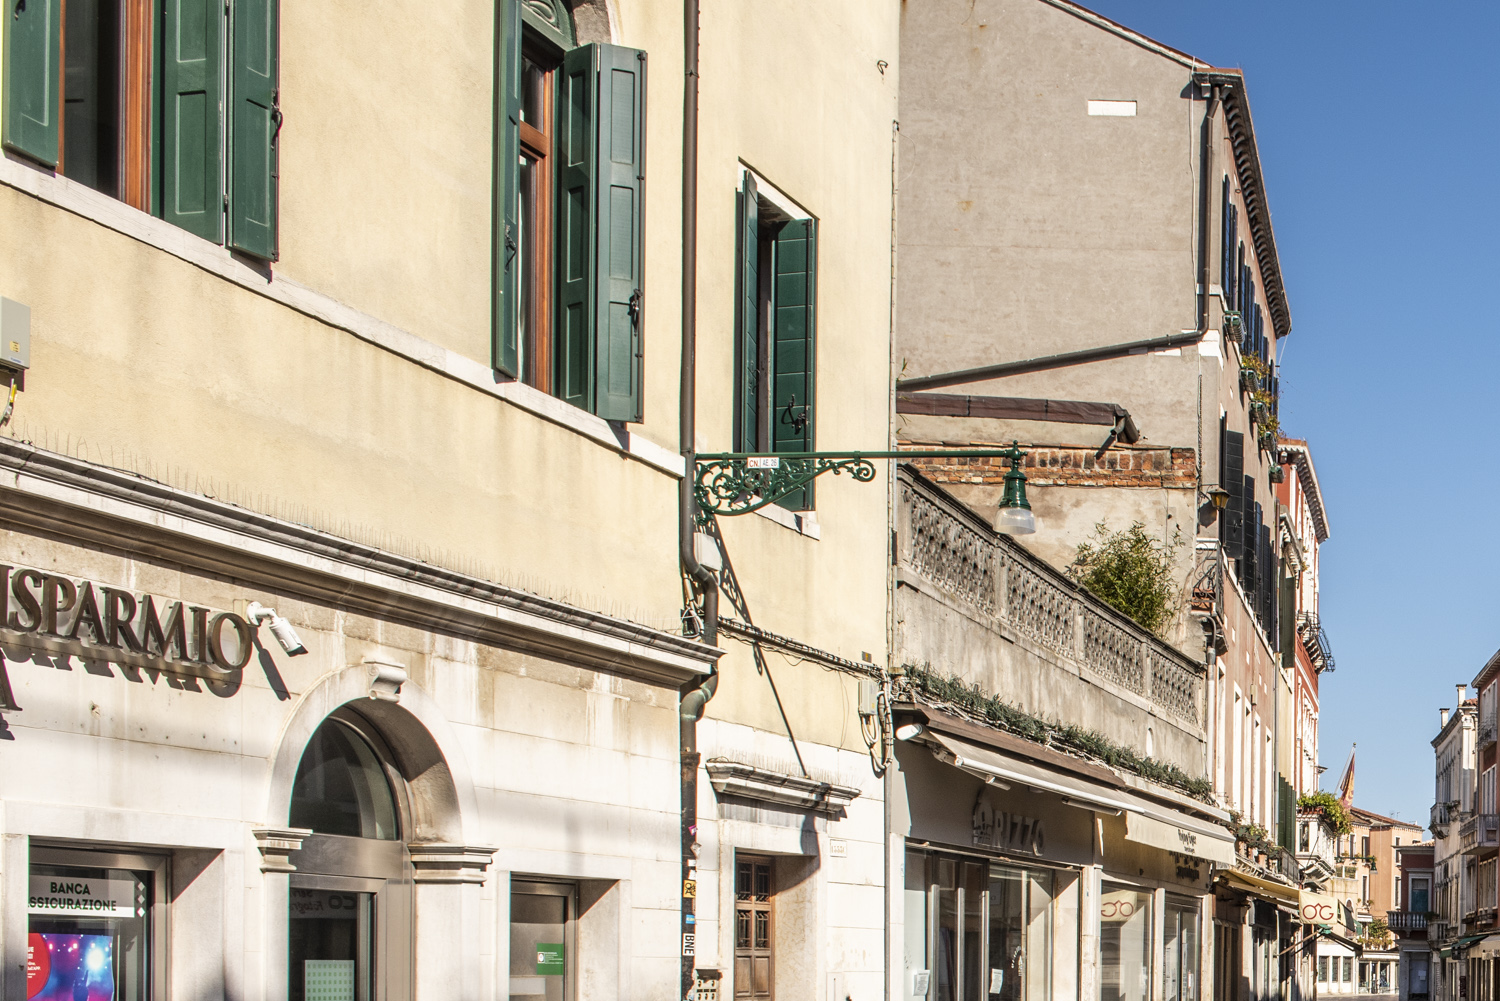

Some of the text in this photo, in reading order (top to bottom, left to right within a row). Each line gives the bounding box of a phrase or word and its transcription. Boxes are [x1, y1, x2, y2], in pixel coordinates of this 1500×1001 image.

[0, 564, 252, 670] ISPARMIO
[50, 882, 90, 895] BANCA
[28, 896, 116, 912] SSICURAZIONE
